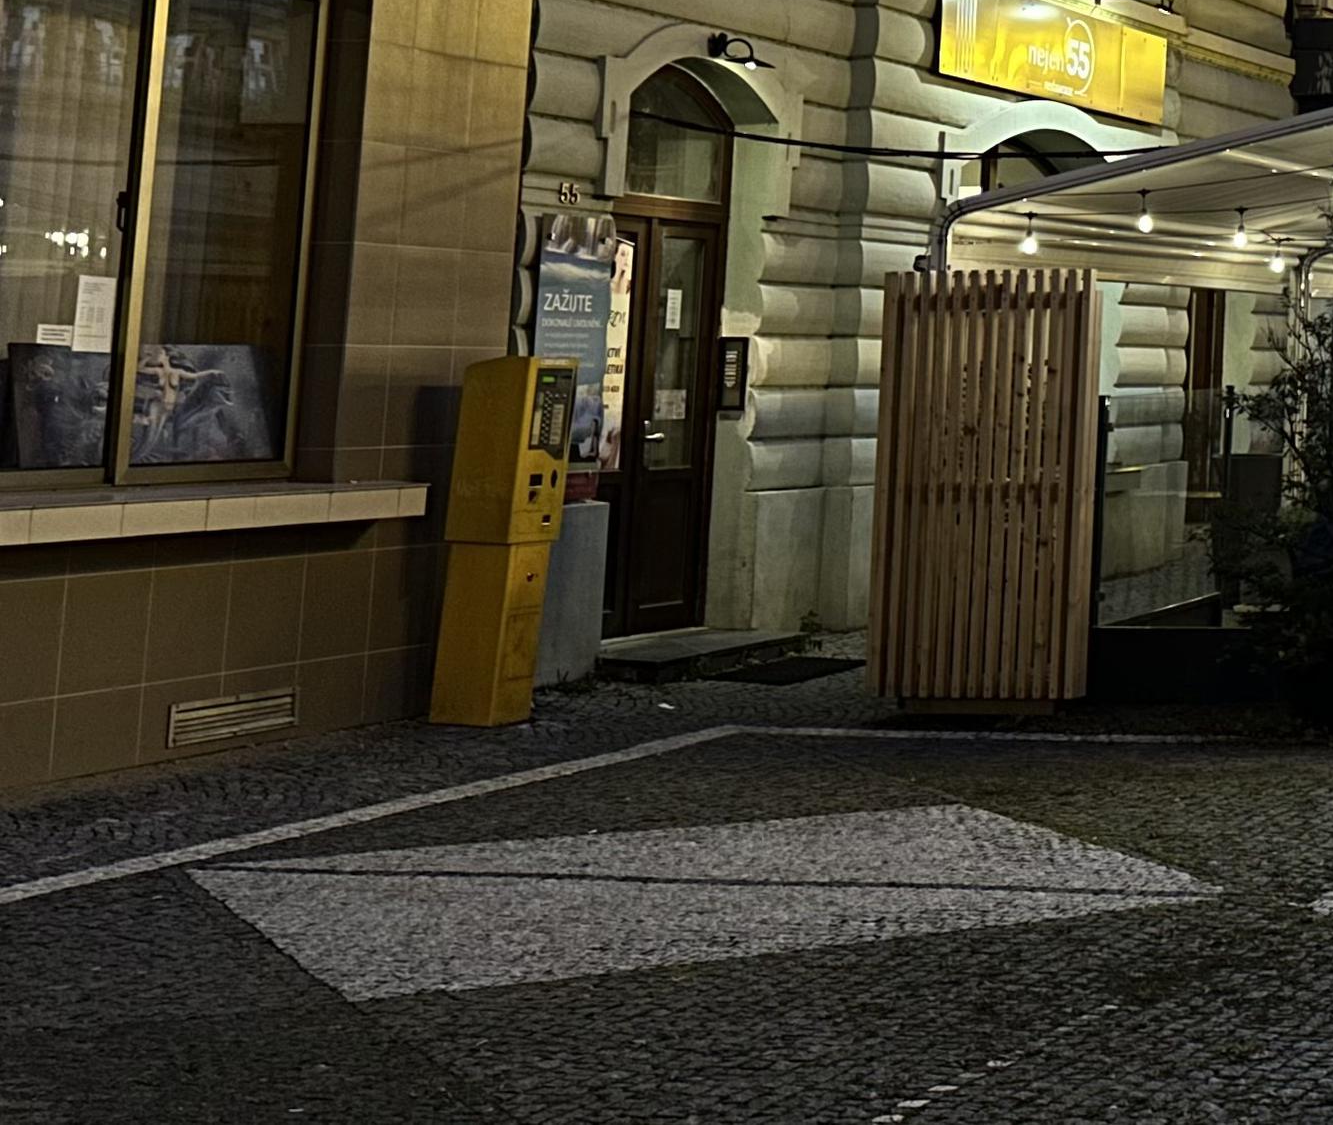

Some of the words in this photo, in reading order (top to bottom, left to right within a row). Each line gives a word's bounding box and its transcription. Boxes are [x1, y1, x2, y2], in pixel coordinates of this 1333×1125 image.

[1028, 44, 1065, 75] nejen
[1066, 39, 1090, 79] 55
[559, 182, 580, 205] 55
[543, 288, 593, 313] ZAŽUTE
